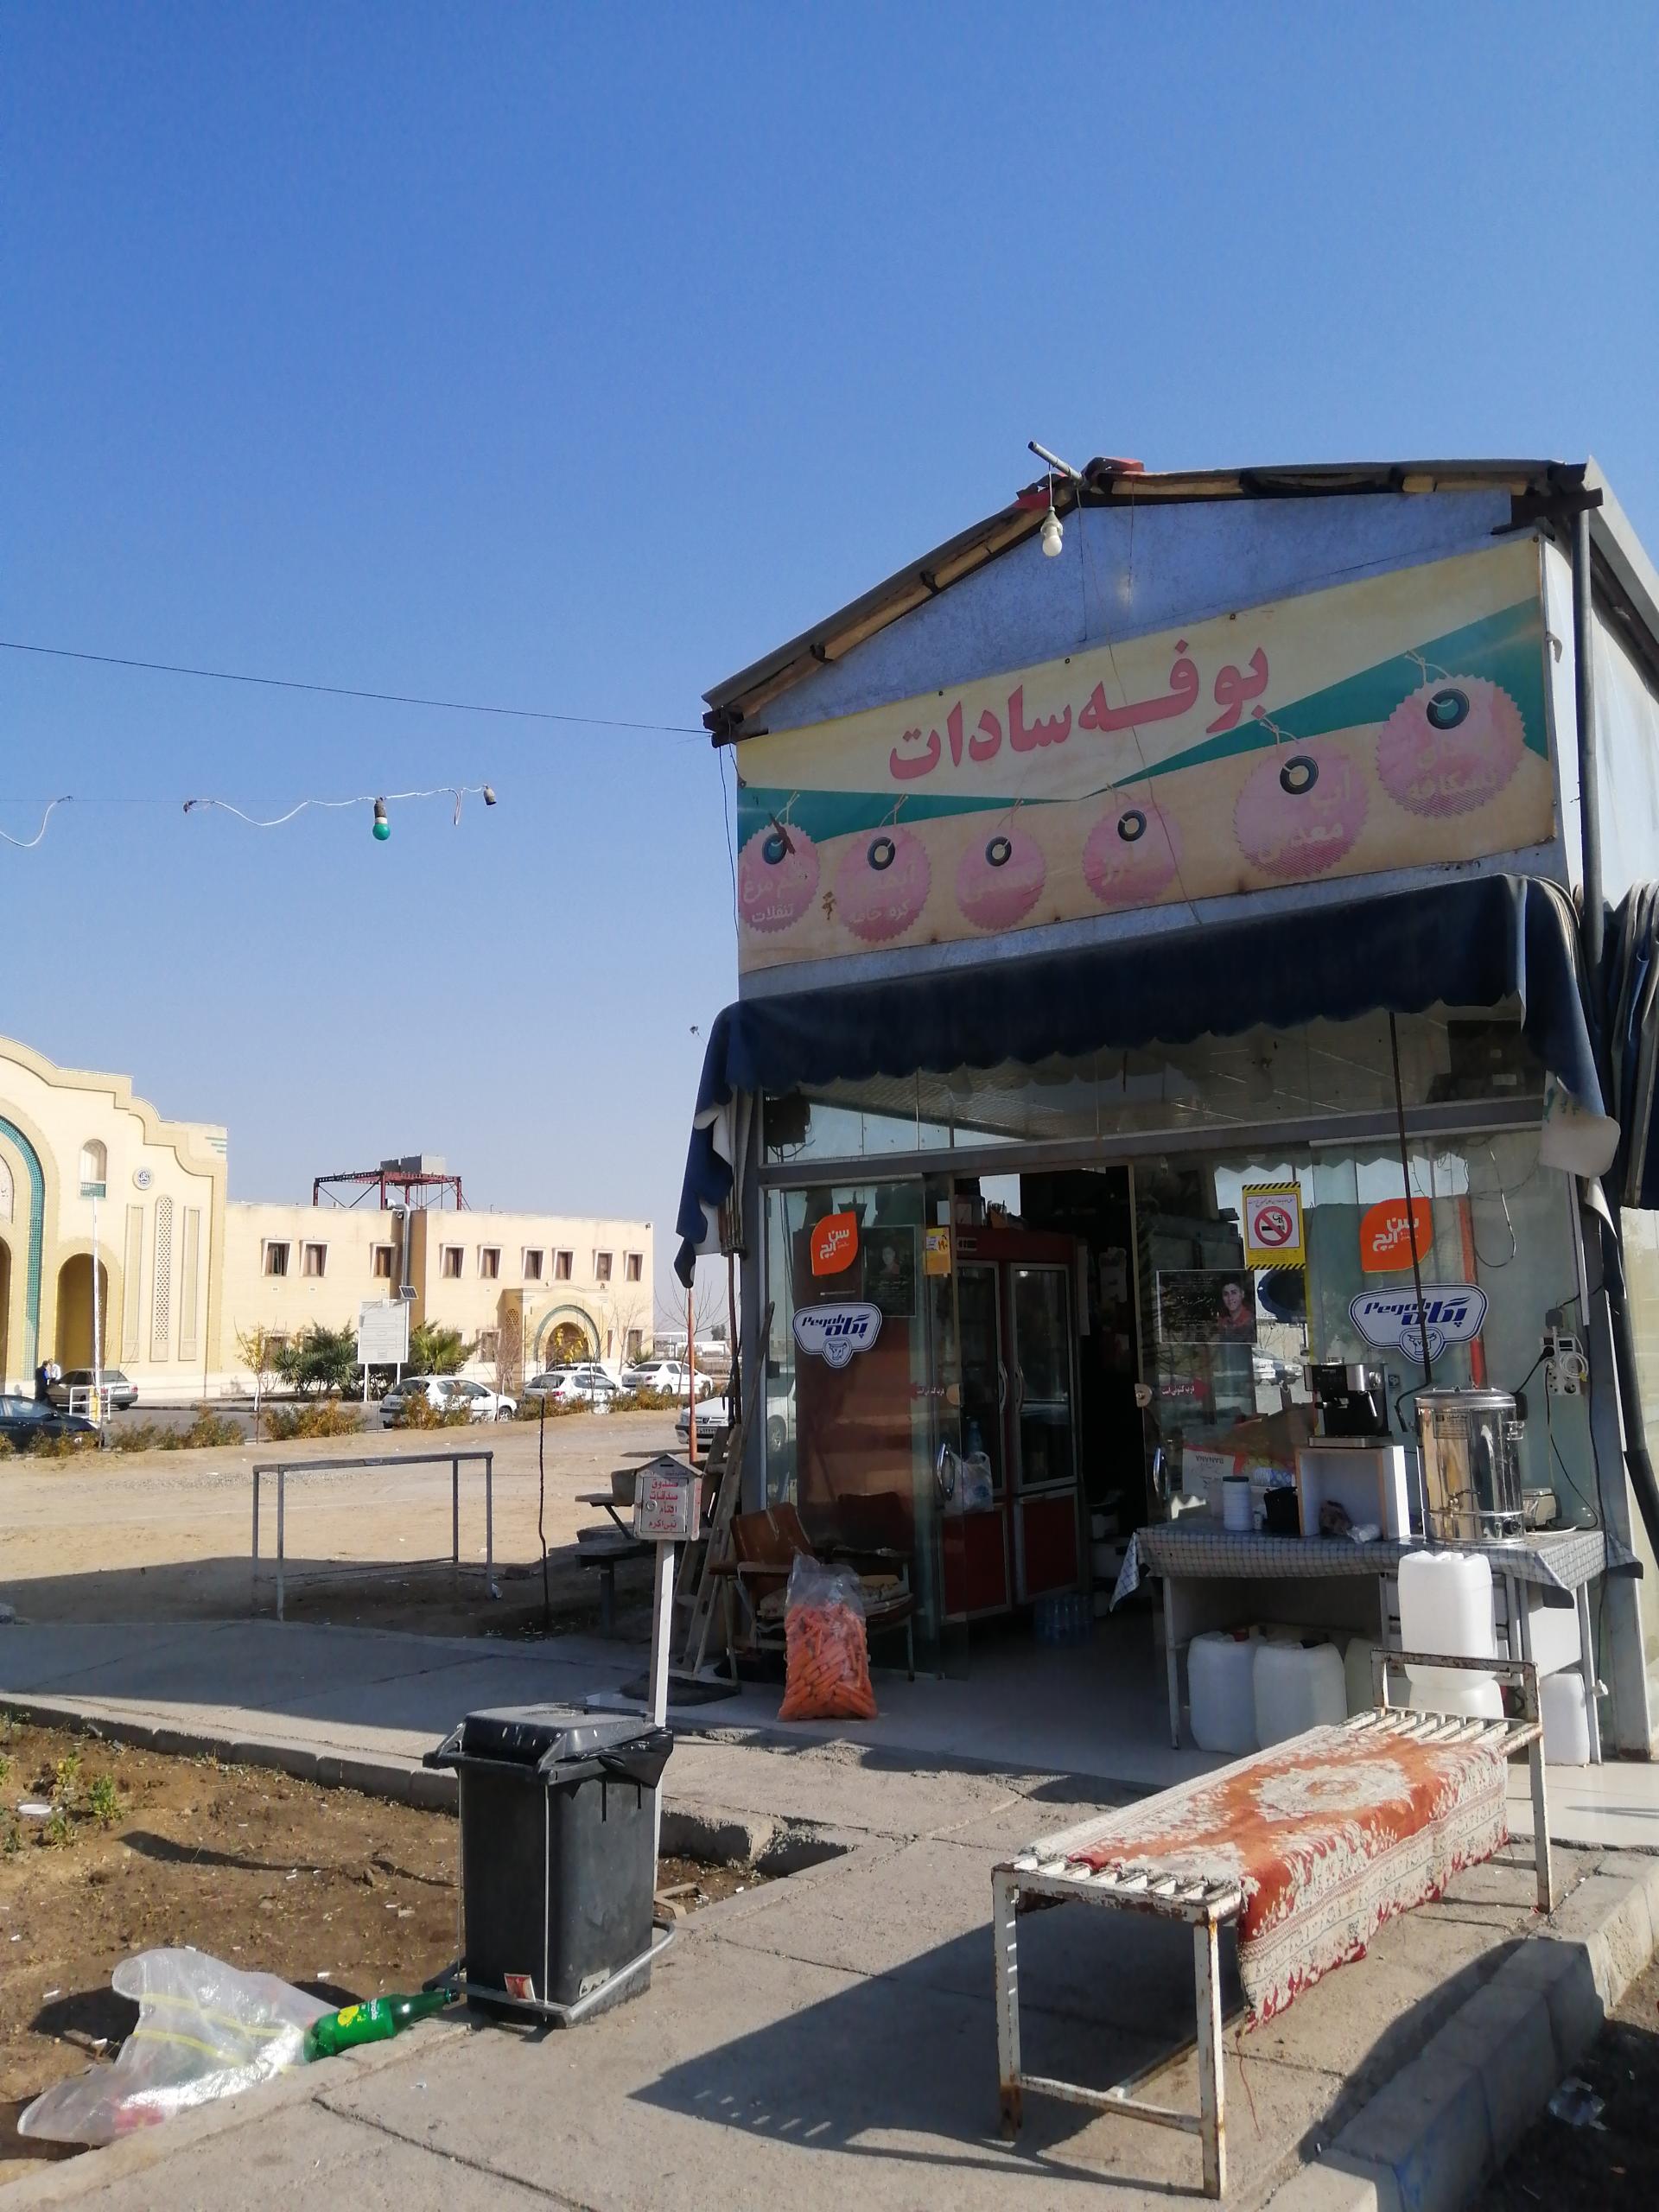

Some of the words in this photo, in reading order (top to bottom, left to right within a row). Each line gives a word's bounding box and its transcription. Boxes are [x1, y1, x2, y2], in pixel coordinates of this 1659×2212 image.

[1077, 639, 1269, 734] بوفه
[888, 683, 1071, 781] سادات
[752, 902, 796, 923] تنقلات
[827, 1228, 850, 1243] سن
[1372, 1229, 1398, 1252] ایچ
[820, 1241, 837, 1260] ایچ
[801, 1313, 846, 1328] Pegah
[1401, 1296, 1471, 1328] پگاه
[824, 1313, 871, 1339] پگاه
[652, 1478, 678, 1490] صندوق
[649, 1491, 678, 1500] صدقات
